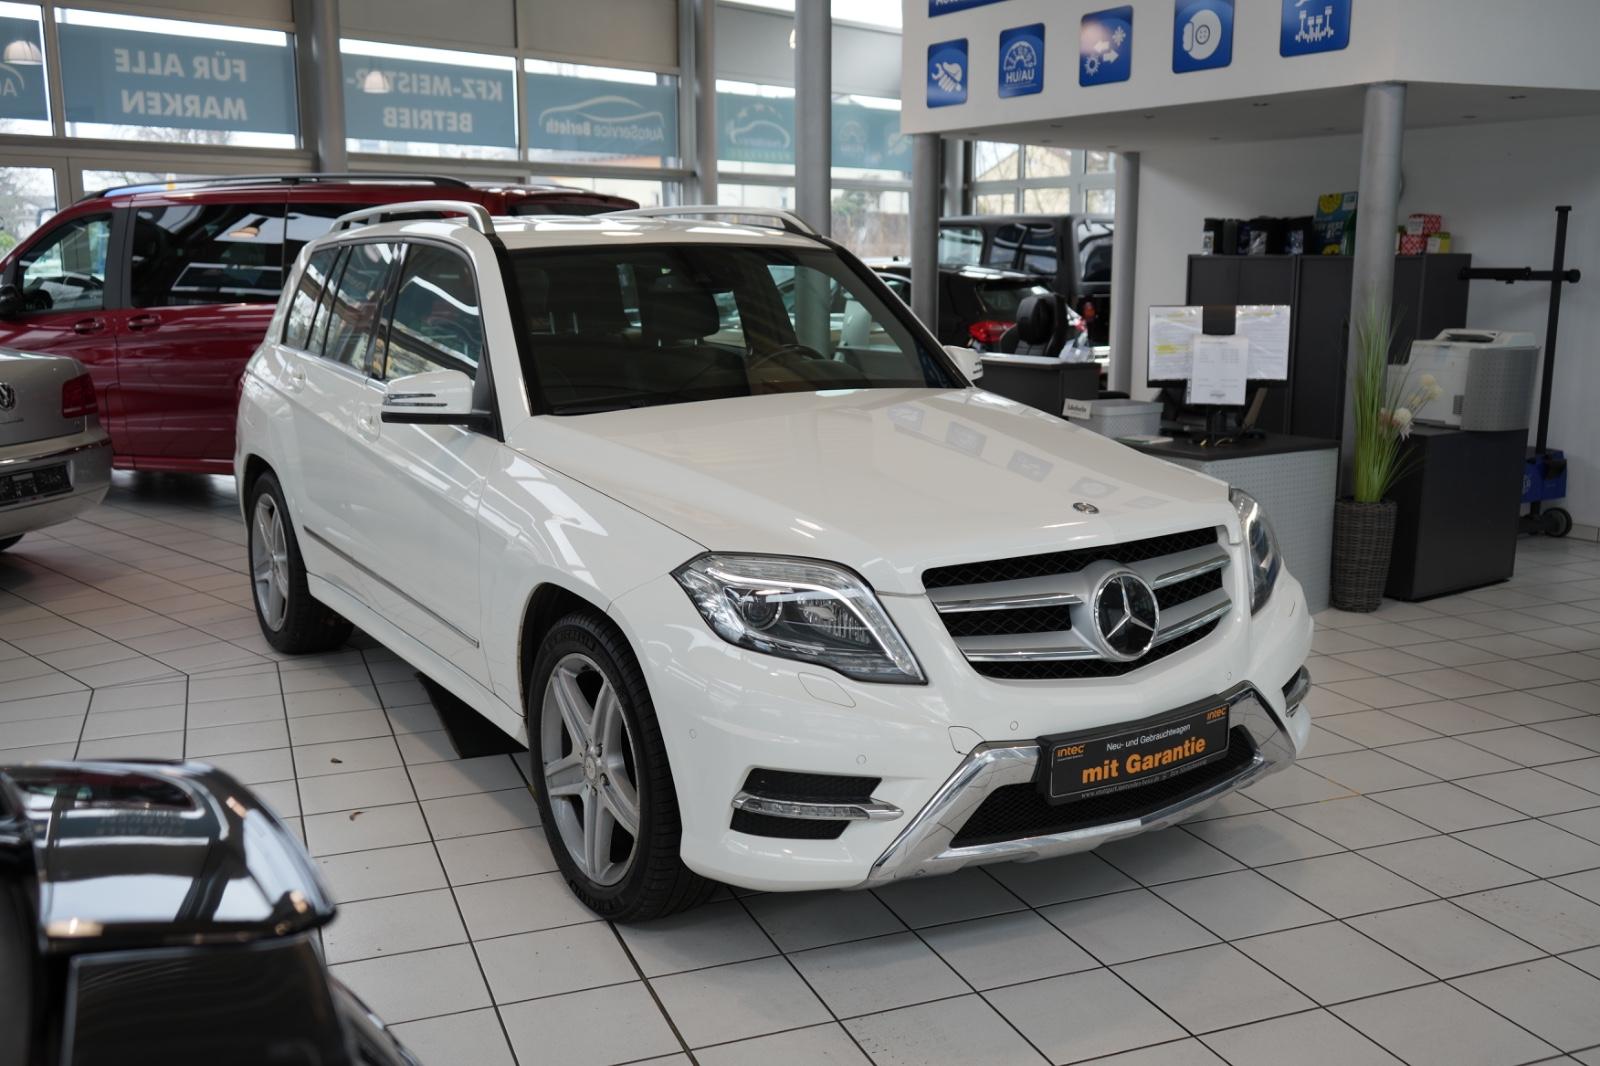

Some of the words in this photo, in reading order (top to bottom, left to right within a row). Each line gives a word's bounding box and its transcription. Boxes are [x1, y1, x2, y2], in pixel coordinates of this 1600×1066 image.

[1006, 68, 1035, 83] HU/AU
[1207, 707, 1227, 721] intec
[1106, 742, 1124, 752] Neu-
[1126, 737, 1139, 747] und
[1140, 723, 1191, 744] Gebrauchtwagen
[1057, 744, 1085, 758] intec
[1082, 759, 1120, 784] mit
[1126, 737, 1207, 774] Garantie
